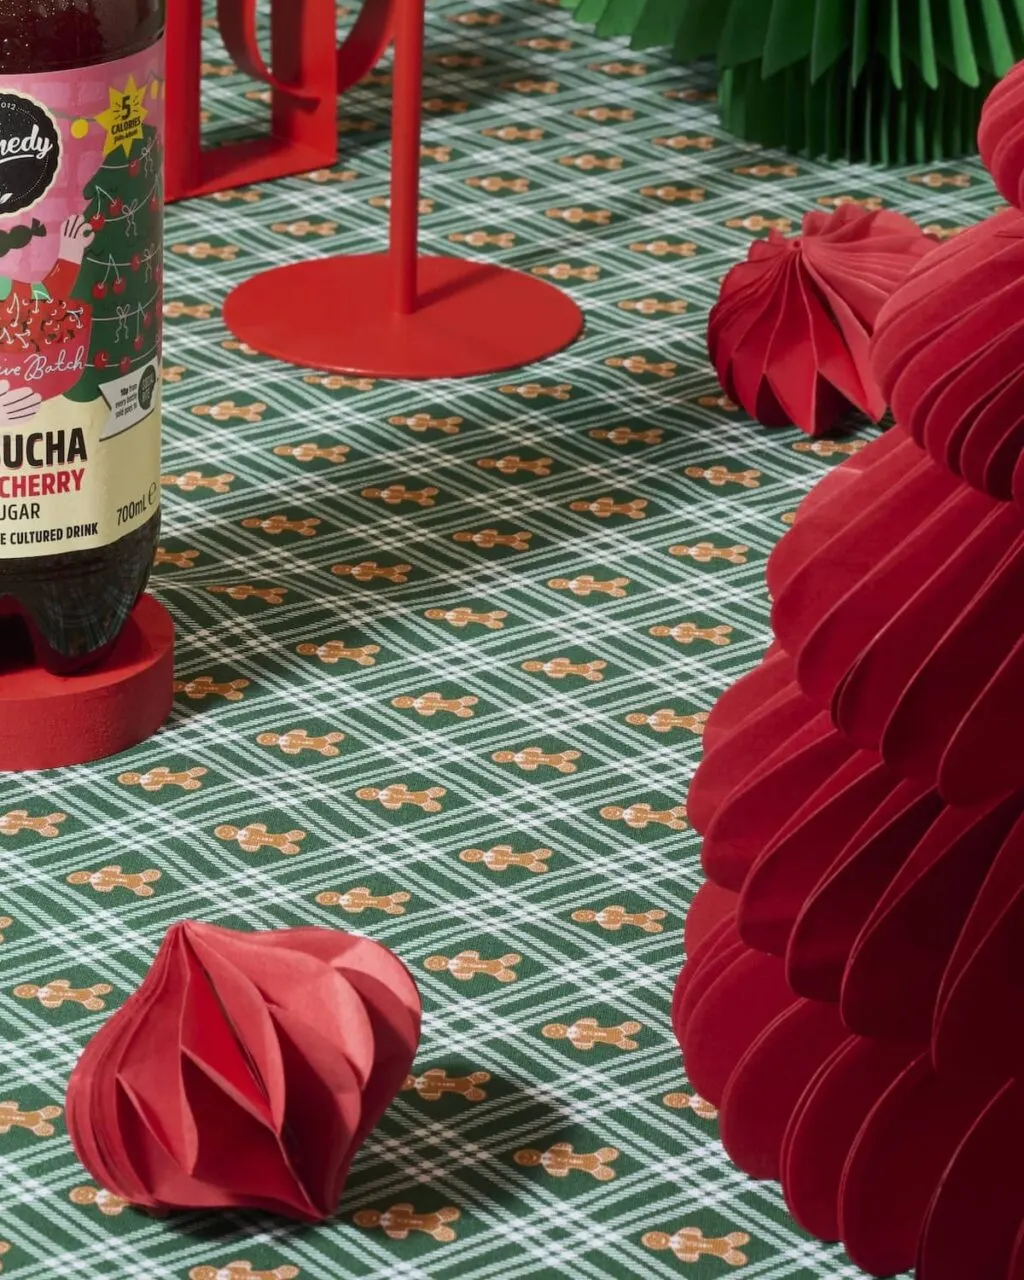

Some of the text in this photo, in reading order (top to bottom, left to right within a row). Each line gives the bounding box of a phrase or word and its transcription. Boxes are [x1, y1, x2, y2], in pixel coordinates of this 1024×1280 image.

[122, 96, 131, 120] 5
[111, 116, 141, 135] CALORIES
[24, 345, 85, 381] Batch
[117, 494, 147, 526] 700mL
[10, 528, 63, 545] CULTURED
[66, 522, 98, 539] DRINK
